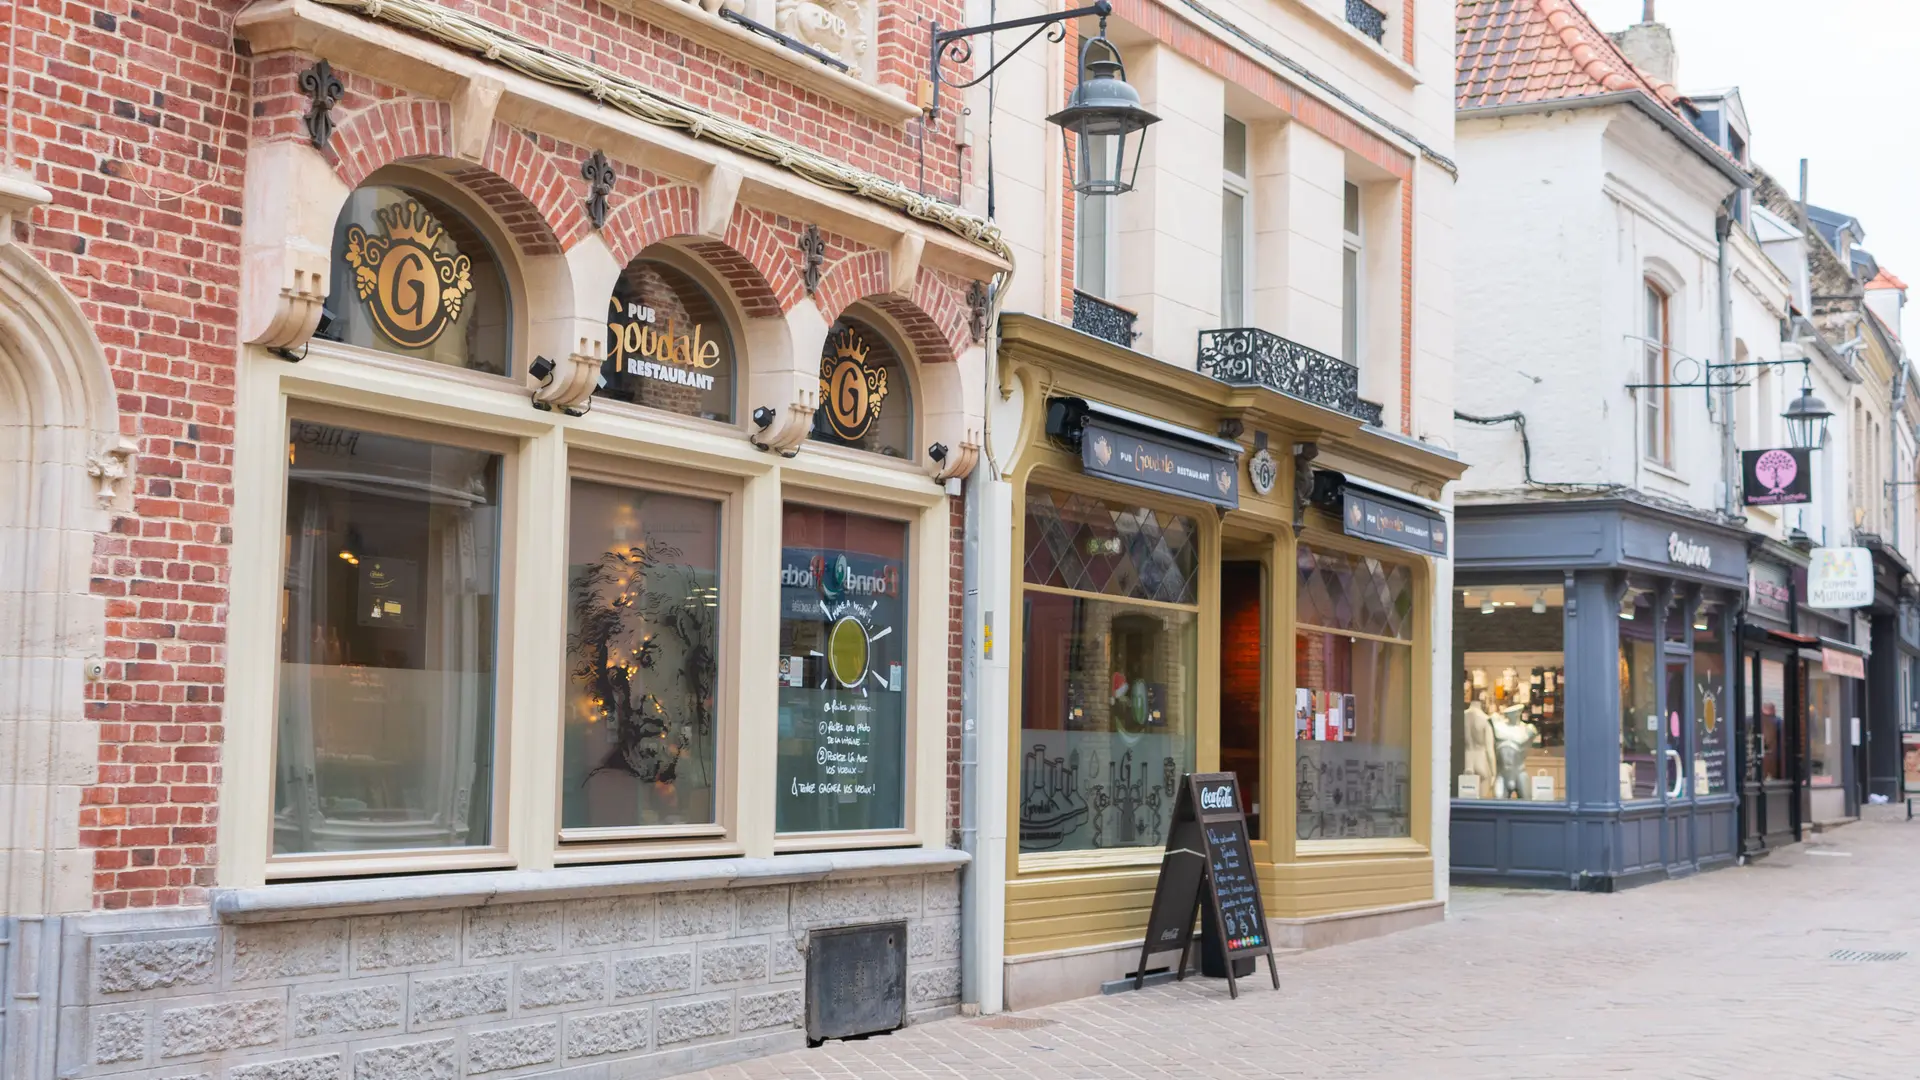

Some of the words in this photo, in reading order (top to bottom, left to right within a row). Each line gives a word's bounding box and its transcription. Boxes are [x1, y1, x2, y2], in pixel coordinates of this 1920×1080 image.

[391, 253, 425, 326] G
[628, 302, 656, 323] PUB
[627, 357, 714, 391] RESTAURANT
[838, 367, 859, 424] G
[1120, 452, 1132, 463] PUB
[1134, 444, 1175, 479] Goudale
[1176, 465, 1210, 482] RESTAURANT
